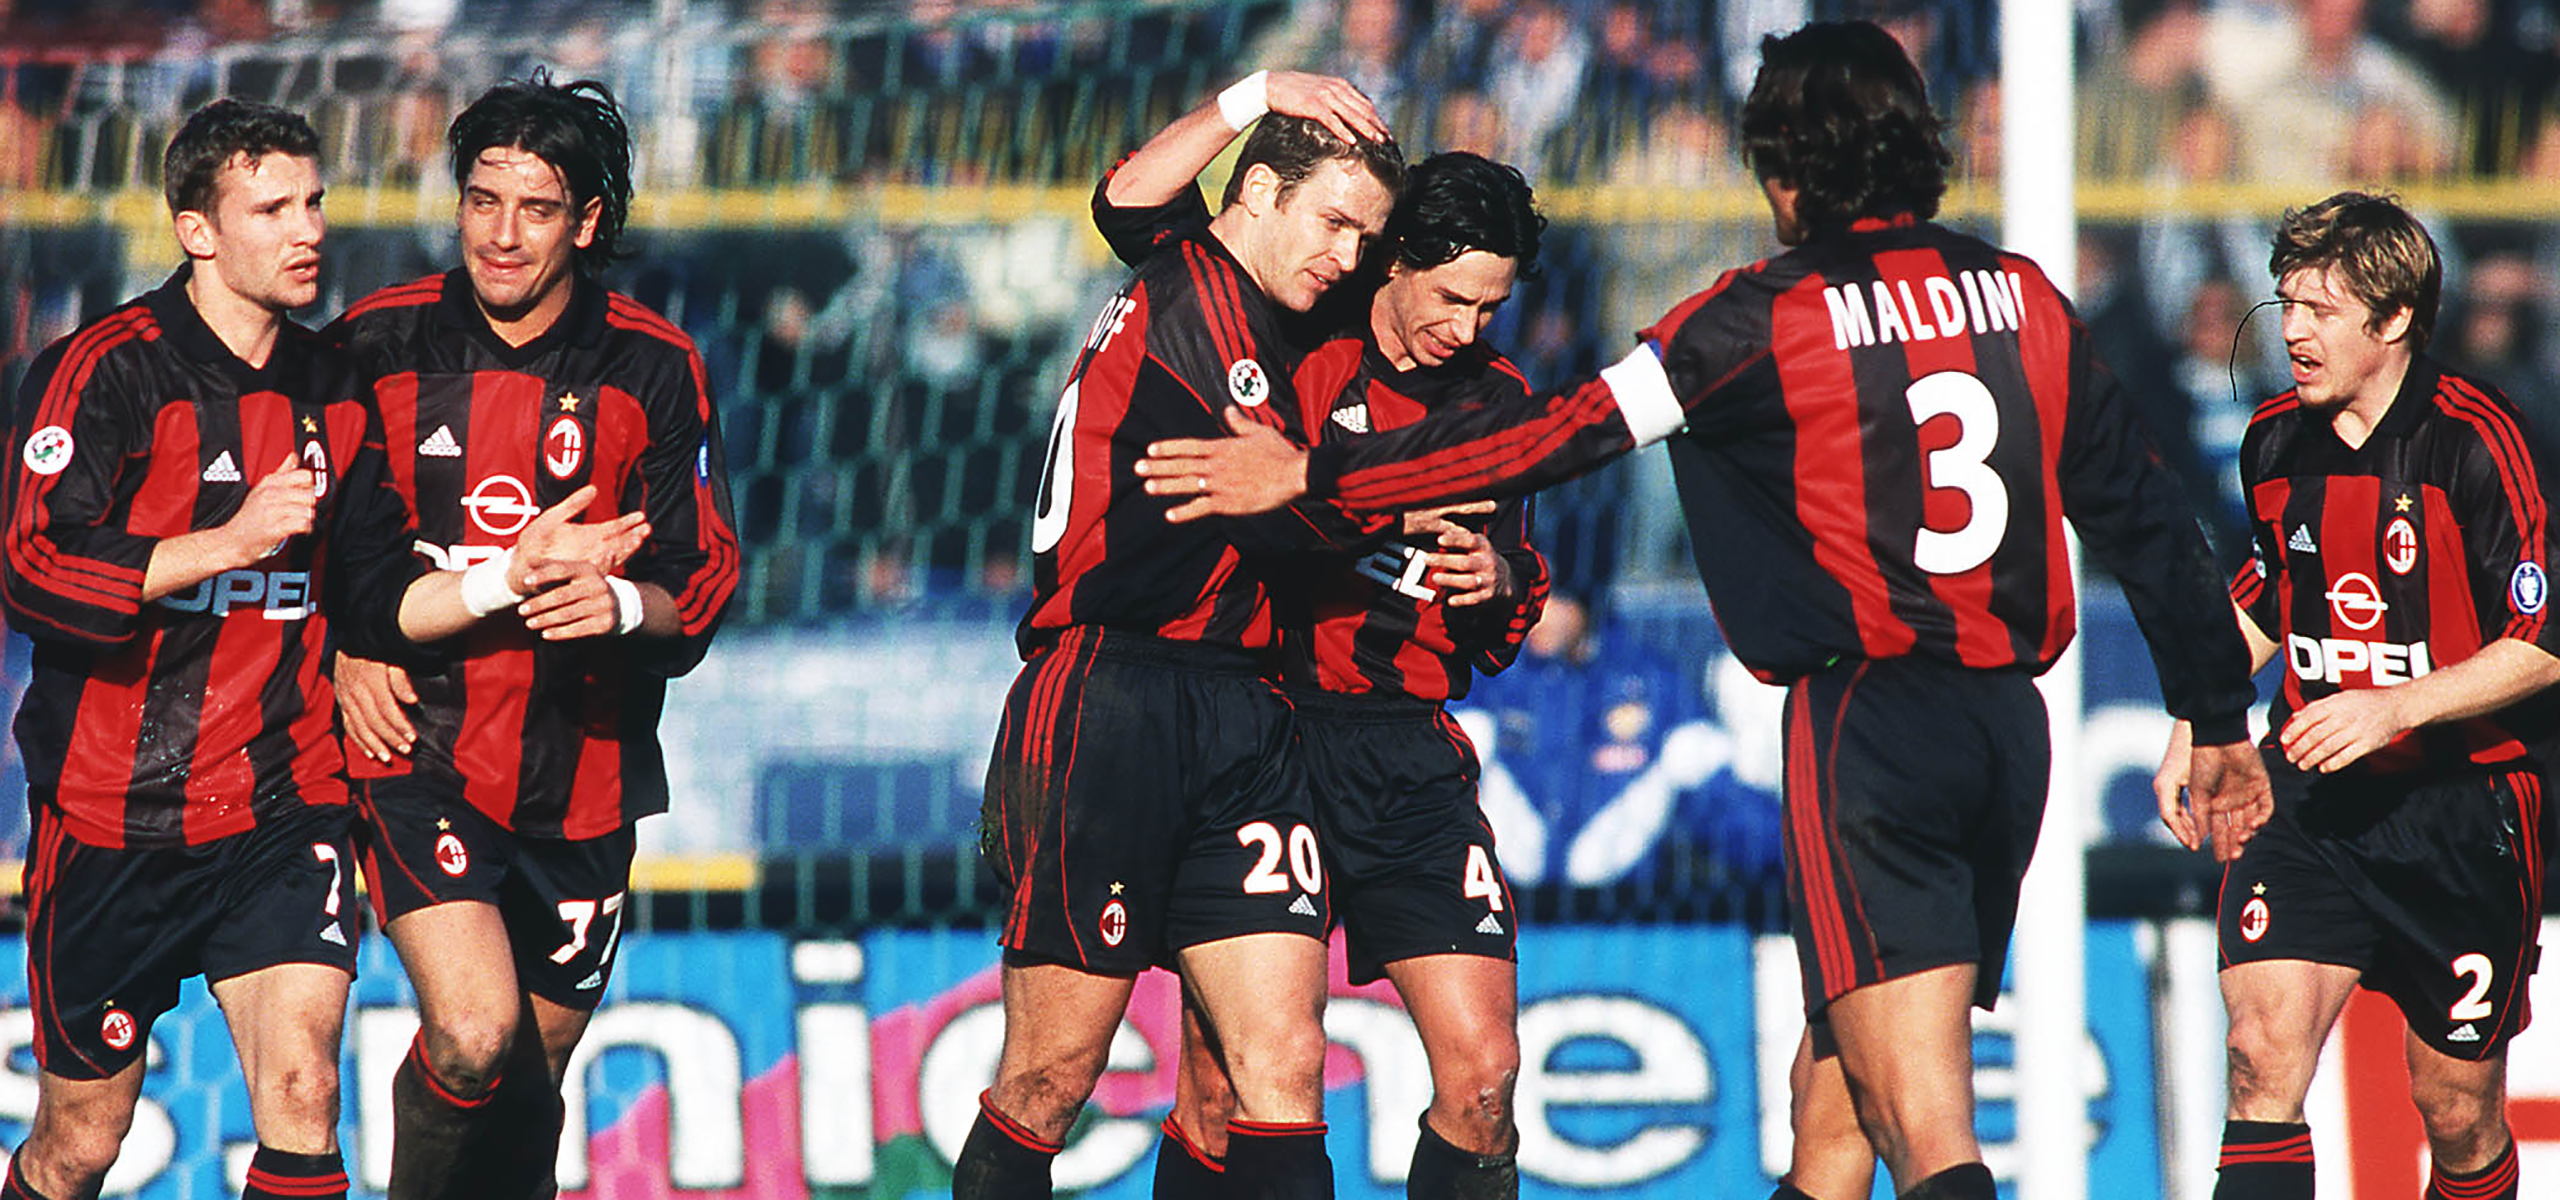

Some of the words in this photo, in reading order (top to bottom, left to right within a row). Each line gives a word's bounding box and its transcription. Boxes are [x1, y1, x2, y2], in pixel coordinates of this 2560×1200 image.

[1822, 269, 2028, 351] MALDINI
[1031, 378, 1081, 555] 0
[1904, 369, 2010, 576] 3
[313, 842, 341, 916] 7
[1236, 821, 1322, 896] 20
[1463, 844, 1504, 912] 4
[2449, 952, 2494, 1021] 2
